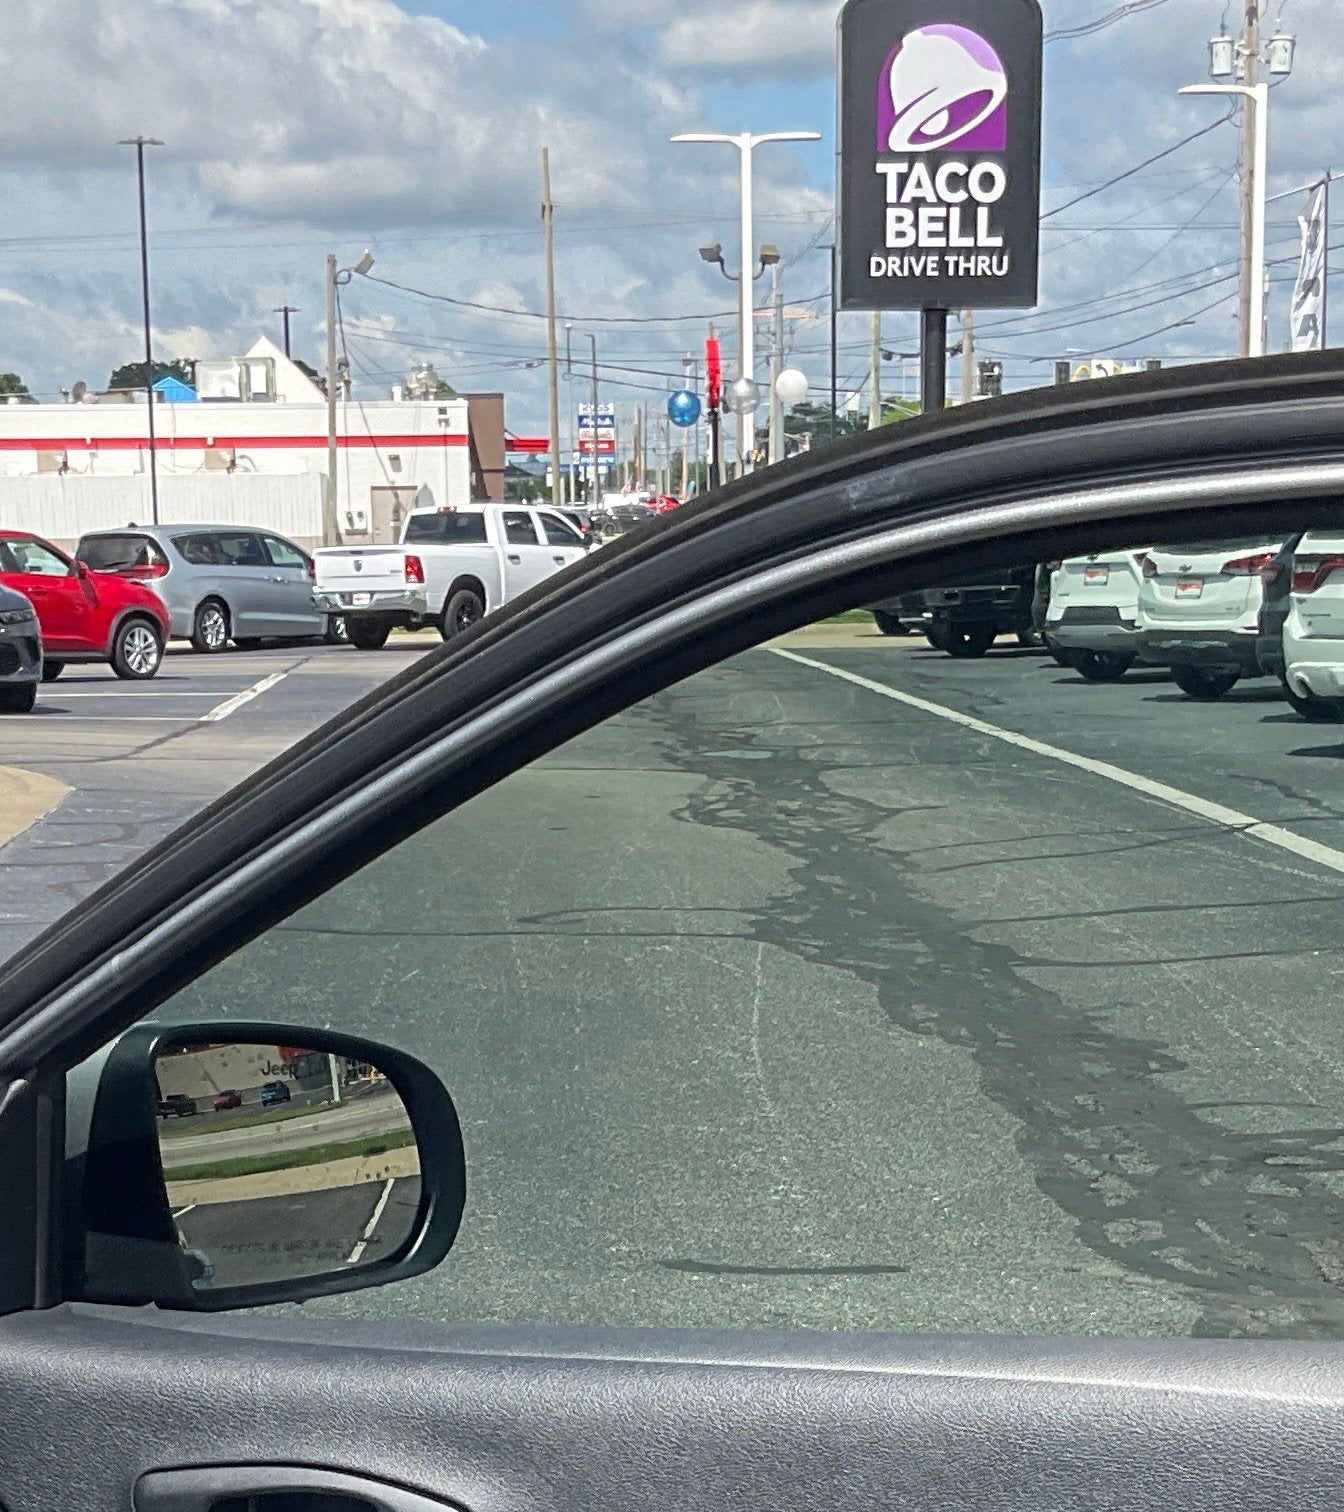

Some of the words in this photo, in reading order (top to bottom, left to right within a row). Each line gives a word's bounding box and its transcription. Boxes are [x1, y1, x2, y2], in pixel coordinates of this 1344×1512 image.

[875, 161, 1006, 204] TACO
[885, 206, 1003, 248] BELL
[869, 255, 939, 278] DRIVE
[944, 254, 1009, 277] THRU
